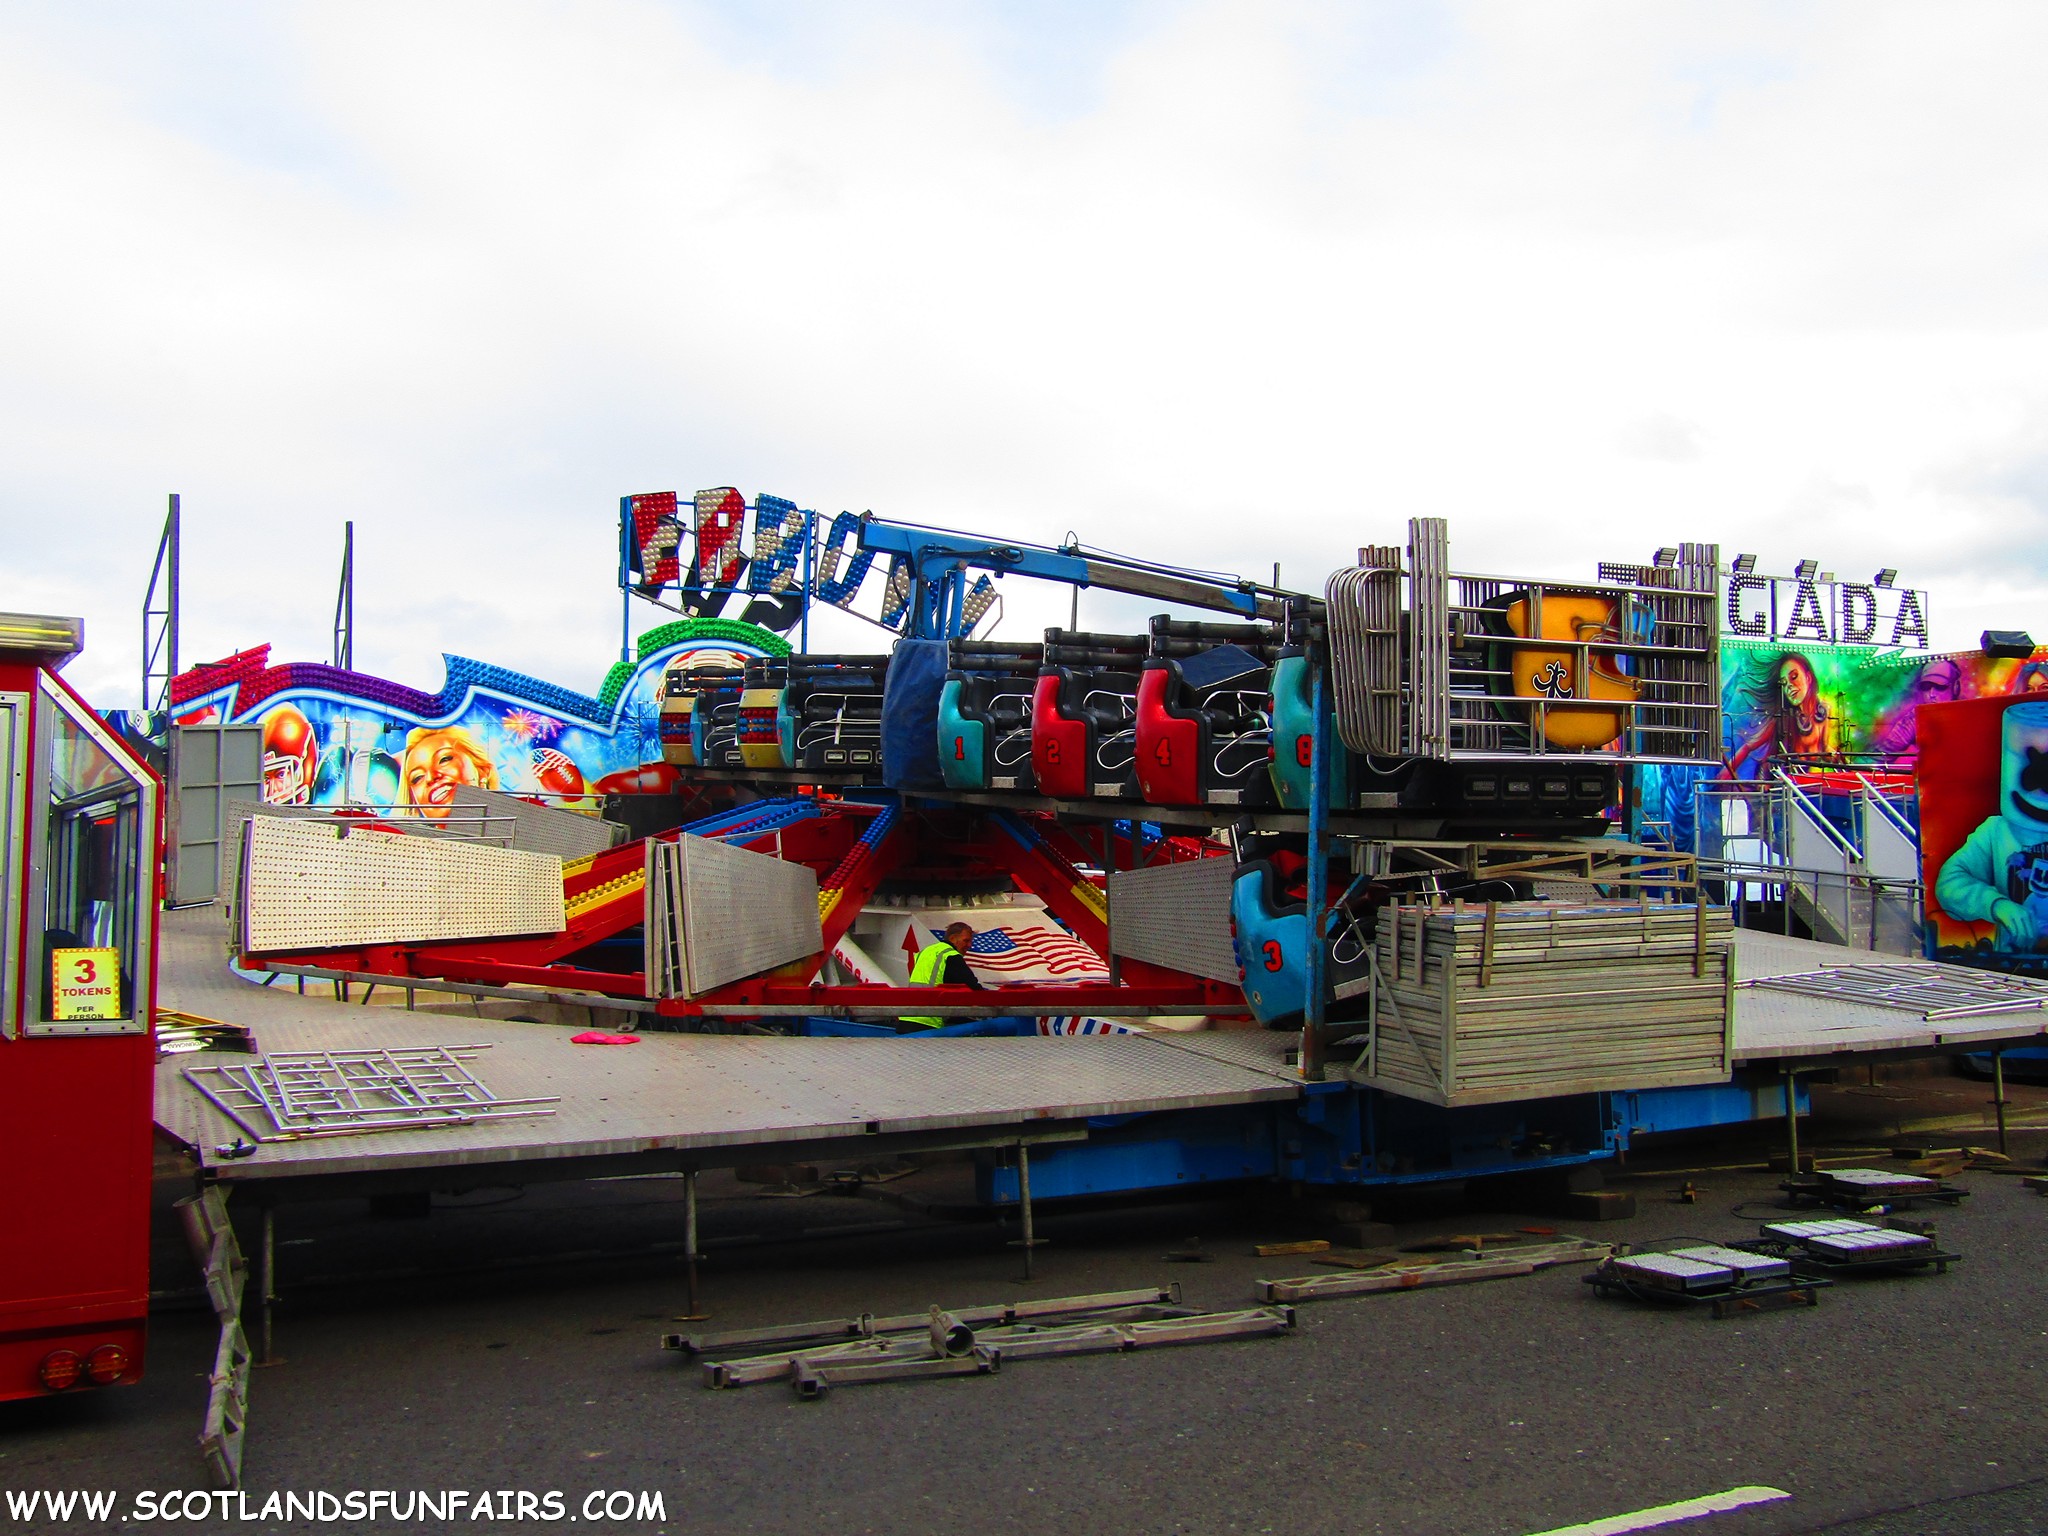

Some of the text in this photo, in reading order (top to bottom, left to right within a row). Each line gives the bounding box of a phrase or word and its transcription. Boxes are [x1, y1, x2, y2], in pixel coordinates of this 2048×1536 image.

[955, 736, 965, 760] 1
[1046, 738, 1060, 764] 2
[1155, 737, 1172, 766] 4
[1263, 939, 1283, 973] 3
[74, 959, 97, 984] 3
[61, 987, 112, 997] TOKENS
